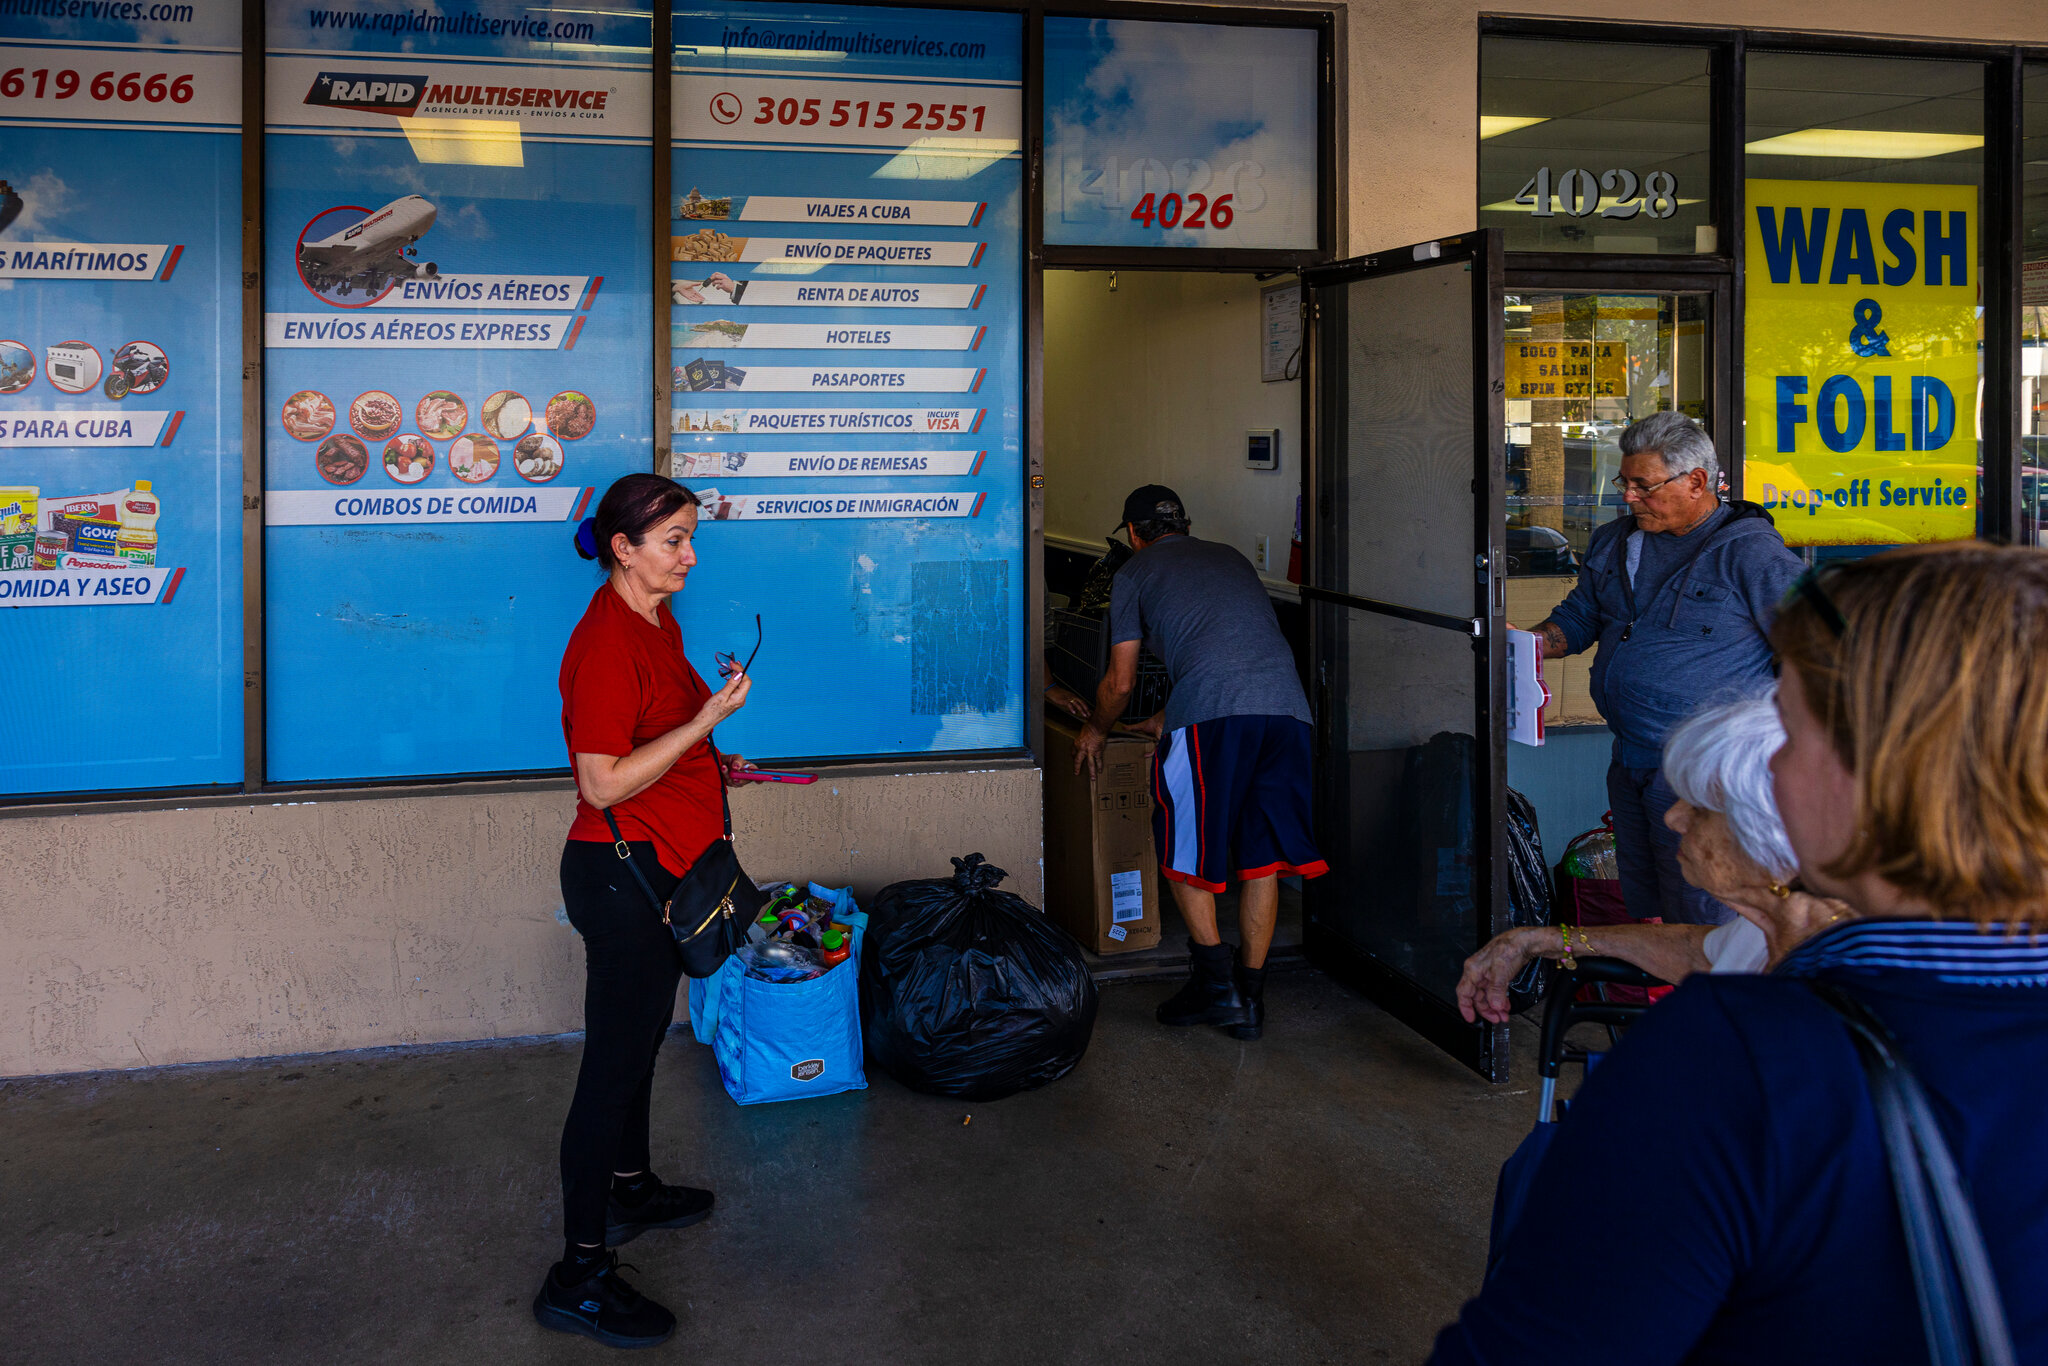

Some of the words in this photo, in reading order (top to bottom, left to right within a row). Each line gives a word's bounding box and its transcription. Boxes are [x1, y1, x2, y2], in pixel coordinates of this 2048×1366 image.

[309, 9, 595, 40] www.rapidmultiservice.com
[721, 26, 987, 59] info@rapidmultiservices.com
[0, 67, 81, 100] 619
[90, 71, 194, 104] 6666
[329, 80, 416, 103] RAPID
[426, 84, 609, 110] MULTISERVICE
[423, 106, 470, 115] AGENCIA
[486, 108, 521, 116] VIAJES
[530, 109, 568, 118] ENVÍOS
[754, 96, 823, 126] 305
[829, 100, 896, 129] 515
[902, 102, 987, 132] 2551
[1514, 166, 1679, 220] 4028
[806, 203, 855, 218] VIAJES
[857, 205, 869, 218] A
[871, 205, 911, 219] CUBA
[1130, 192, 1235, 230] 4026
[785, 242, 832, 259] ENVÍO
[834, 245, 856, 259] DE
[858, 246, 932, 262] PAQUETES
[1755, 205, 1969, 287] WASH
[11, 248, 149, 271] MARÍTIMOS
[403, 278, 484, 301] ENVÍOS
[487, 278, 571, 302] AÉREOS
[797, 287, 845, 302] RENTA
[847, 287, 869, 302] DE
[870, 288, 920, 303] AUTOS
[284, 318, 367, 341] ENVÍOS
[371, 318, 456, 341] AÉREOS
[460, 322, 552, 342] EXPRESS
[826, 330, 891, 344] HOTELES
[1850, 297, 1893, 358] &
[1520, 346, 1557, 358] SOLO
[812, 373, 906, 387] PASAPORTES
[1539, 364, 1589, 376] SALIR
[1520, 382, 1556, 395] SPIN
[749, 413, 826, 430] PAQUETES
[829, 411, 913, 428] TURÍSTICOS
[927, 411, 960, 419] INCLUYE
[1775, 374, 1957, 453] FOLD
[12, 419, 70, 438] PARA
[75, 419, 133, 438] CUBA
[927, 418, 960, 430] VISA
[788, 455, 835, 471] ENVÍO
[838, 457, 859, 471] DE
[861, 456, 928, 471] REMESAS
[334, 497, 423, 517] COMBOS
[427, 497, 453, 516] DE
[458, 495, 538, 516] COMIDA
[756, 499, 833, 514] SERVICIOS
[835, 499, 856, 514] DE
[859, 495, 960, 513] INMIGRACIÓN
[1762, 478, 1871, 516] Drop-off
[1880, 477, 1968, 508] Service
[66, 502, 98, 513] IBERIA
[0, 555, 33, 570] LAVE
[77, 578, 91, 596] Y
[93, 576, 151, 596] ASEO
